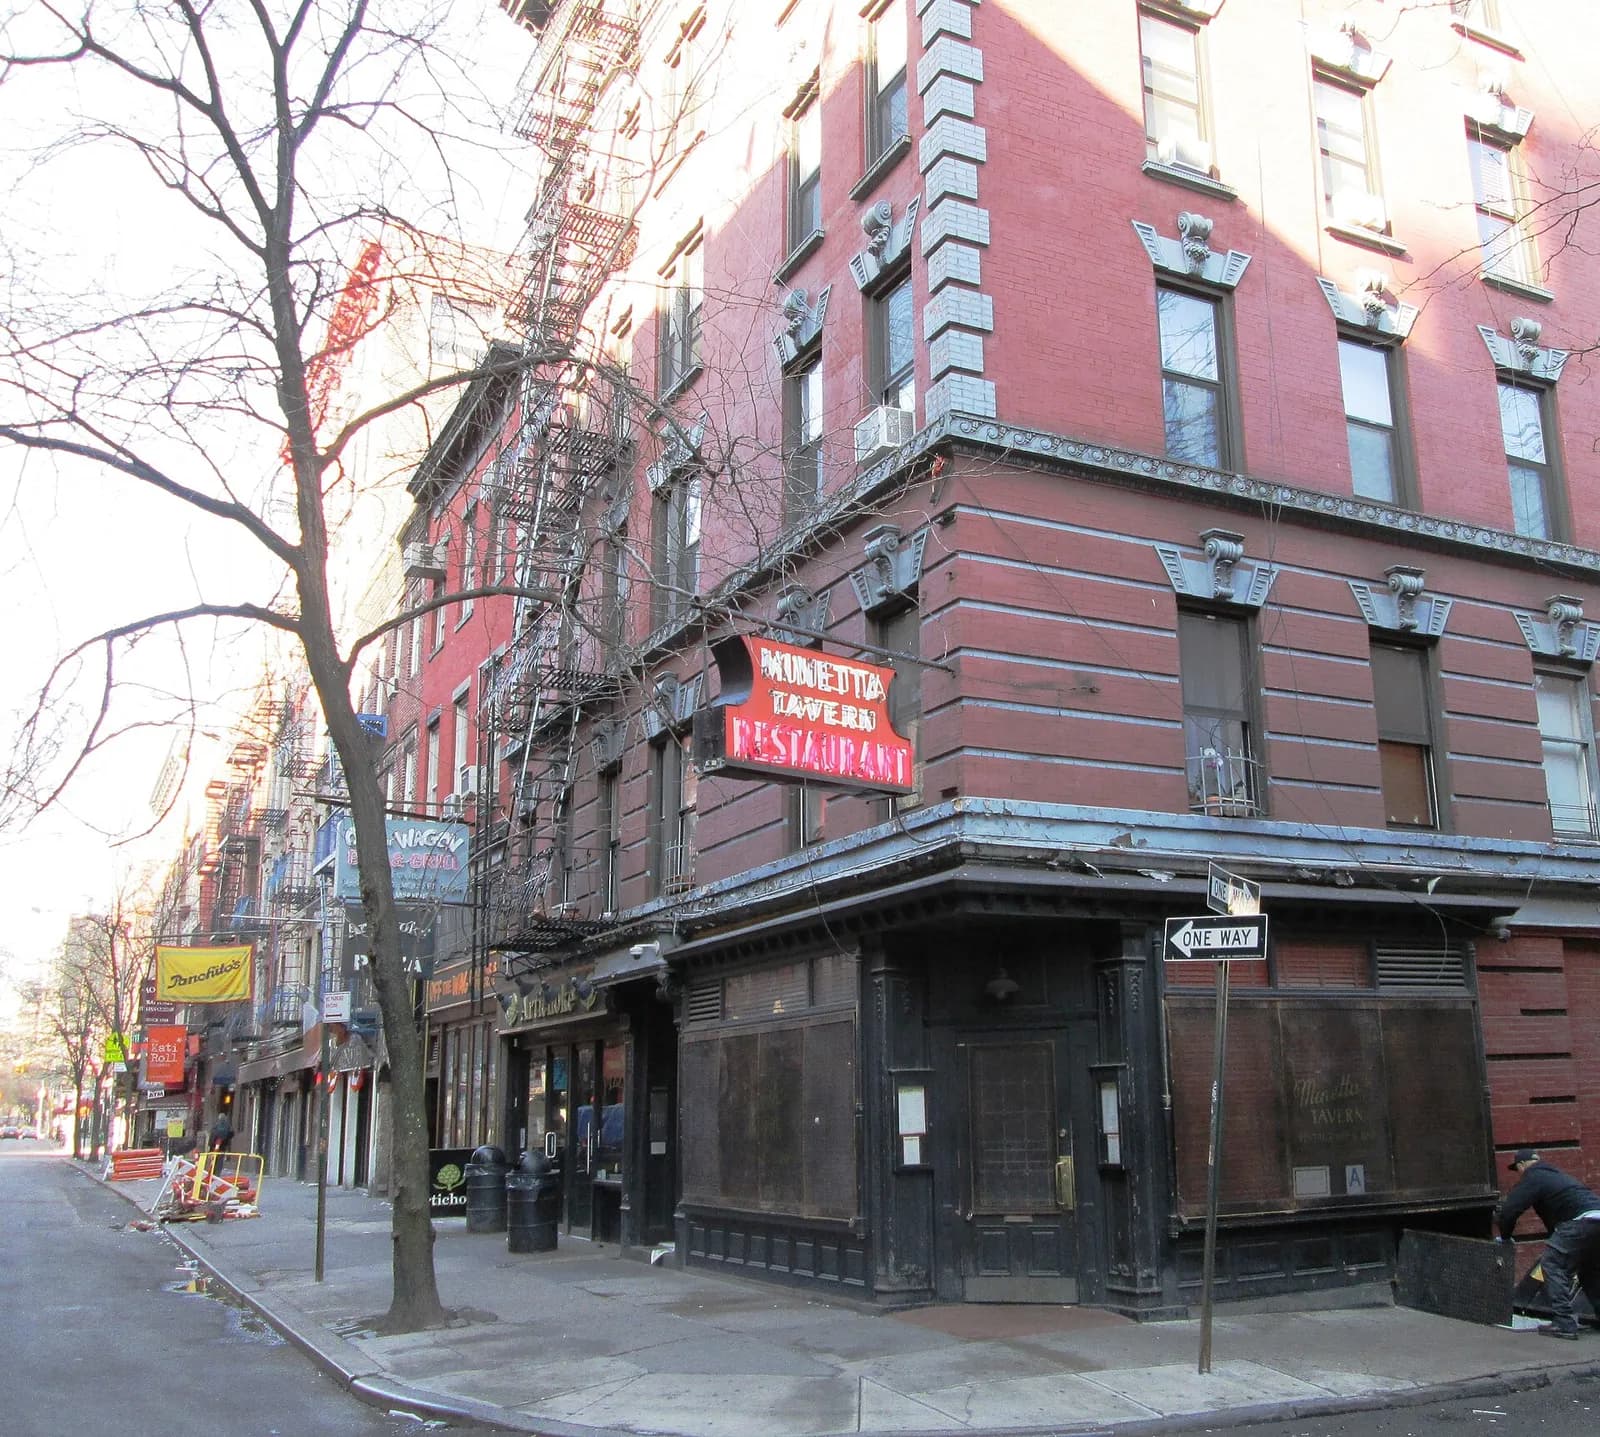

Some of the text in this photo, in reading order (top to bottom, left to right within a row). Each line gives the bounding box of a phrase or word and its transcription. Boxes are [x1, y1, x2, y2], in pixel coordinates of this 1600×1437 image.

[769, 688, 876, 733] TAVERN
[732, 716, 907, 785] RESTAURANT
[1182, 929, 1251, 947] ONE WAY
[167, 959, 241, 989] Panchito's
[151, 1042, 178, 1054] Kati
[150, 1053, 178, 1064] Roll
[1349, 1167, 1361, 1188] A
[428, 1192, 467, 1206] ticho
